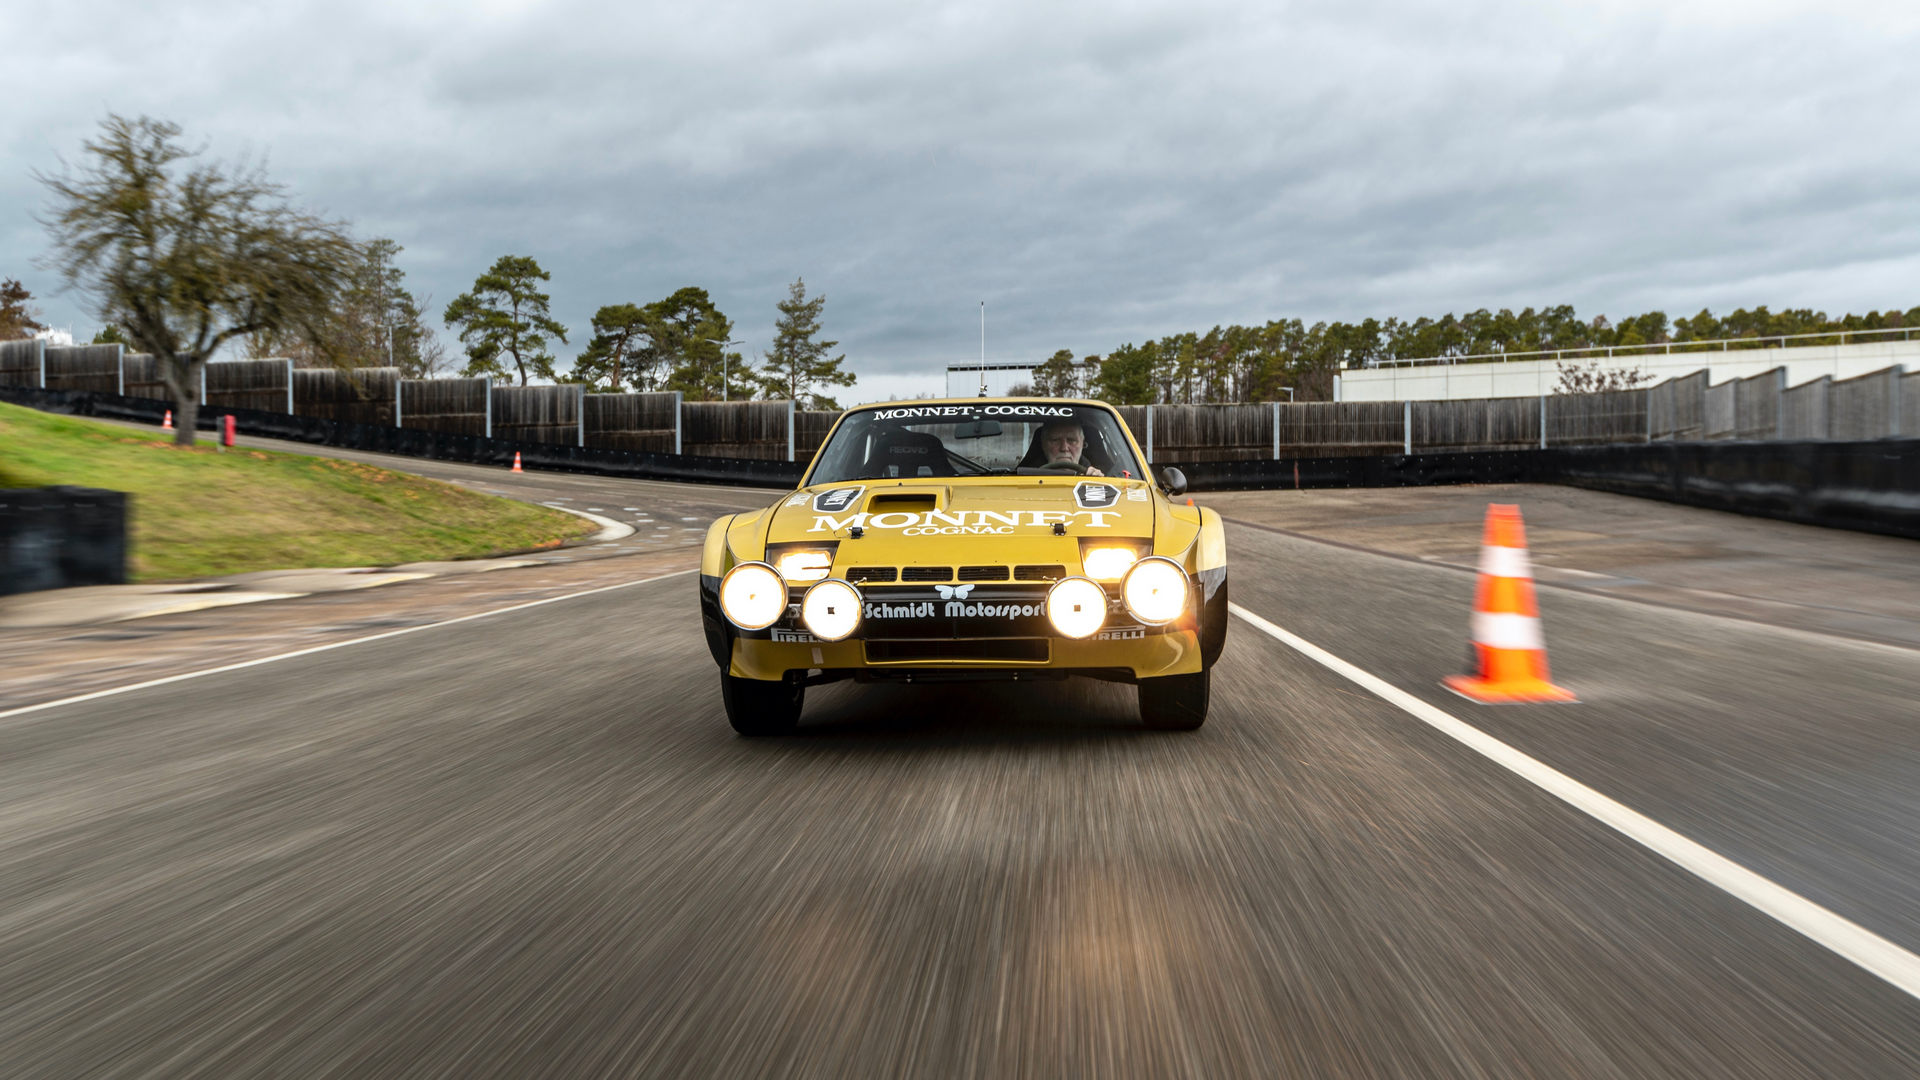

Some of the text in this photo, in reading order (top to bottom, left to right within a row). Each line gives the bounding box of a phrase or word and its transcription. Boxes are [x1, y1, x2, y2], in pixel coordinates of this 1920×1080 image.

[806, 511, 1122, 533] MONNET
[903, 526, 1015, 536] COGNAC
[865, 601, 1046, 621] Schmidt Motorsport
[770, 627, 823, 643] PIREL
[1091, 625, 1146, 641] IRELLI
